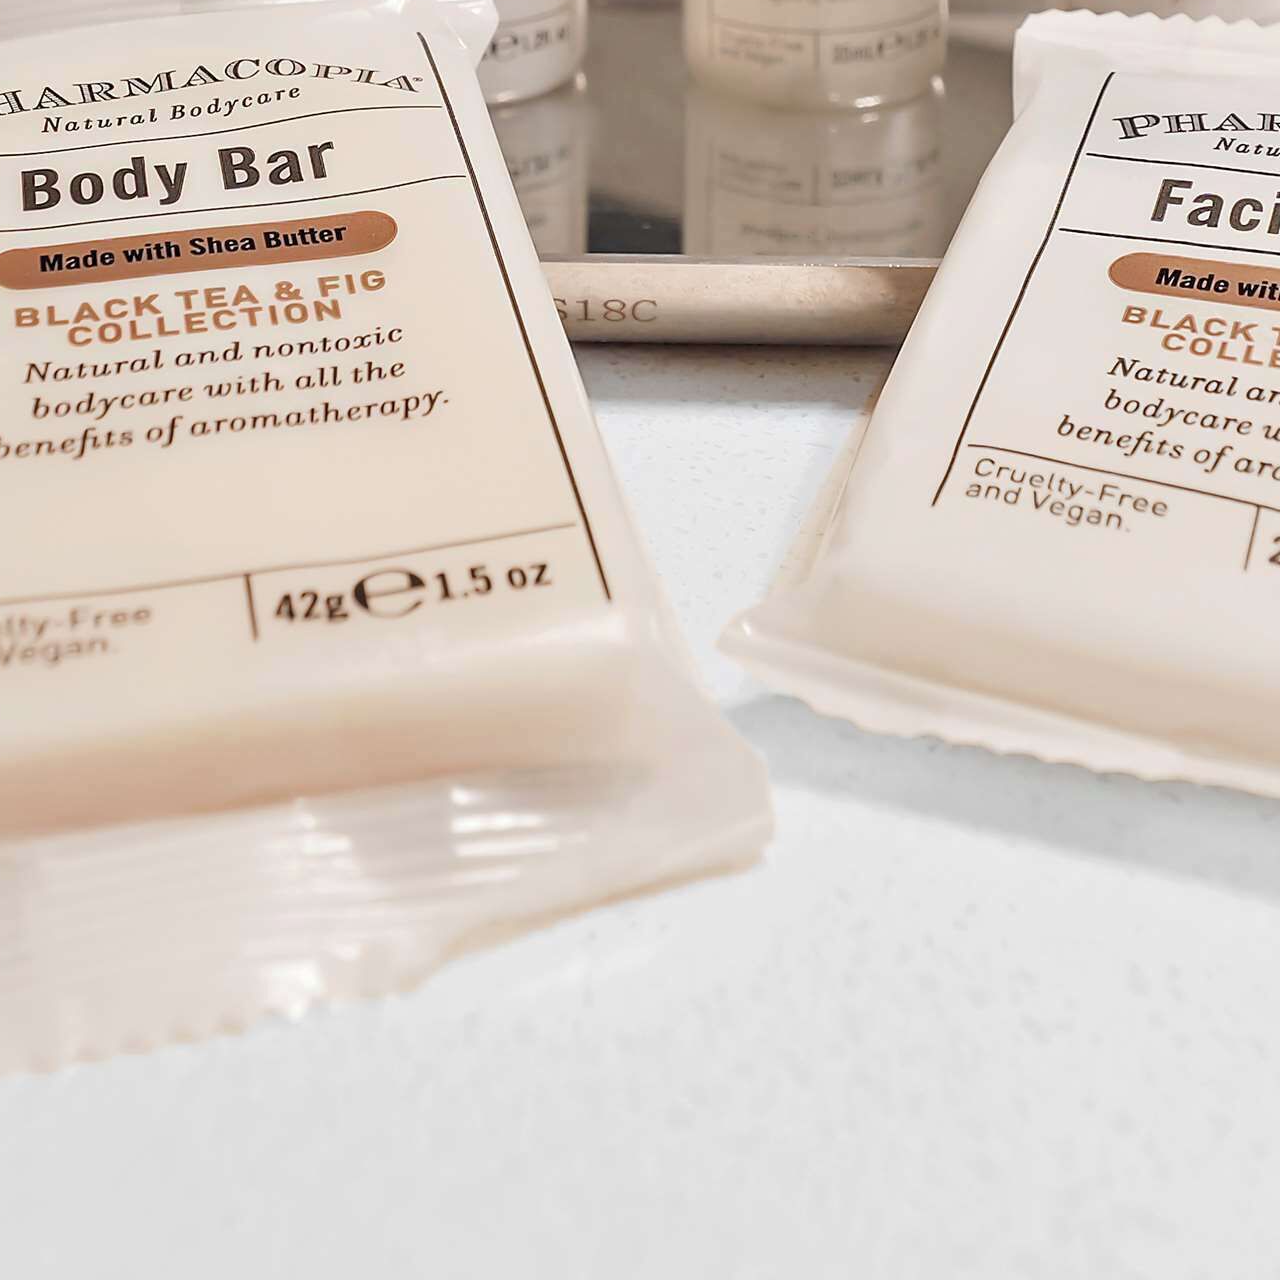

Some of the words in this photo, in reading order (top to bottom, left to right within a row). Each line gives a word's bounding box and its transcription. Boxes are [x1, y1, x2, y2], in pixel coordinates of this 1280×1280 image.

[42, 109, 157, 134] Natural
[171, 87, 302, 122] Bodycare
[21, 156, 188, 212] Body
[218, 139, 336, 191] Bar
[39, 247, 116, 274] Made
[123, 239, 181, 263] with
[189, 231, 257, 256] Shea
[264, 224, 348, 249] Butter
[14, 292, 159, 329] BLACK
[174, 284, 260, 311] TEA
[274, 280, 303, 302] &
[318, 269, 387, 297] FIG
[1155, 266, 1230, 295] Made
[67, 298, 343, 347] COLLECTION
[1121, 304, 1265, 343] BLACK
[23, 349, 165, 385] Natural
[174, 340, 244, 366] and
[253, 324, 405, 359] nontoxic
[1107, 356, 1239, 399] Natural
[30, 383, 194, 421] bodycare
[205, 371, 285, 398] with
[295, 364, 343, 391] all
[351, 357, 406, 383] the
[145, 414, 184, 448] of
[189, 385, 451, 439] aromatherapy.
[1103, 388, 1253, 437] bodycare
[1056, 414, 1186, 461] benefits
[1193, 444, 1232, 473] of
[965, 478, 1023, 506] and
[1031, 489, 1131, 534] Vegan.
[973, 457, 1170, 518] Cruelty-Free
[275, 590, 350, 624] 42g
[435, 564, 495, 603] 1.5
[508, 562, 552, 591] oz
